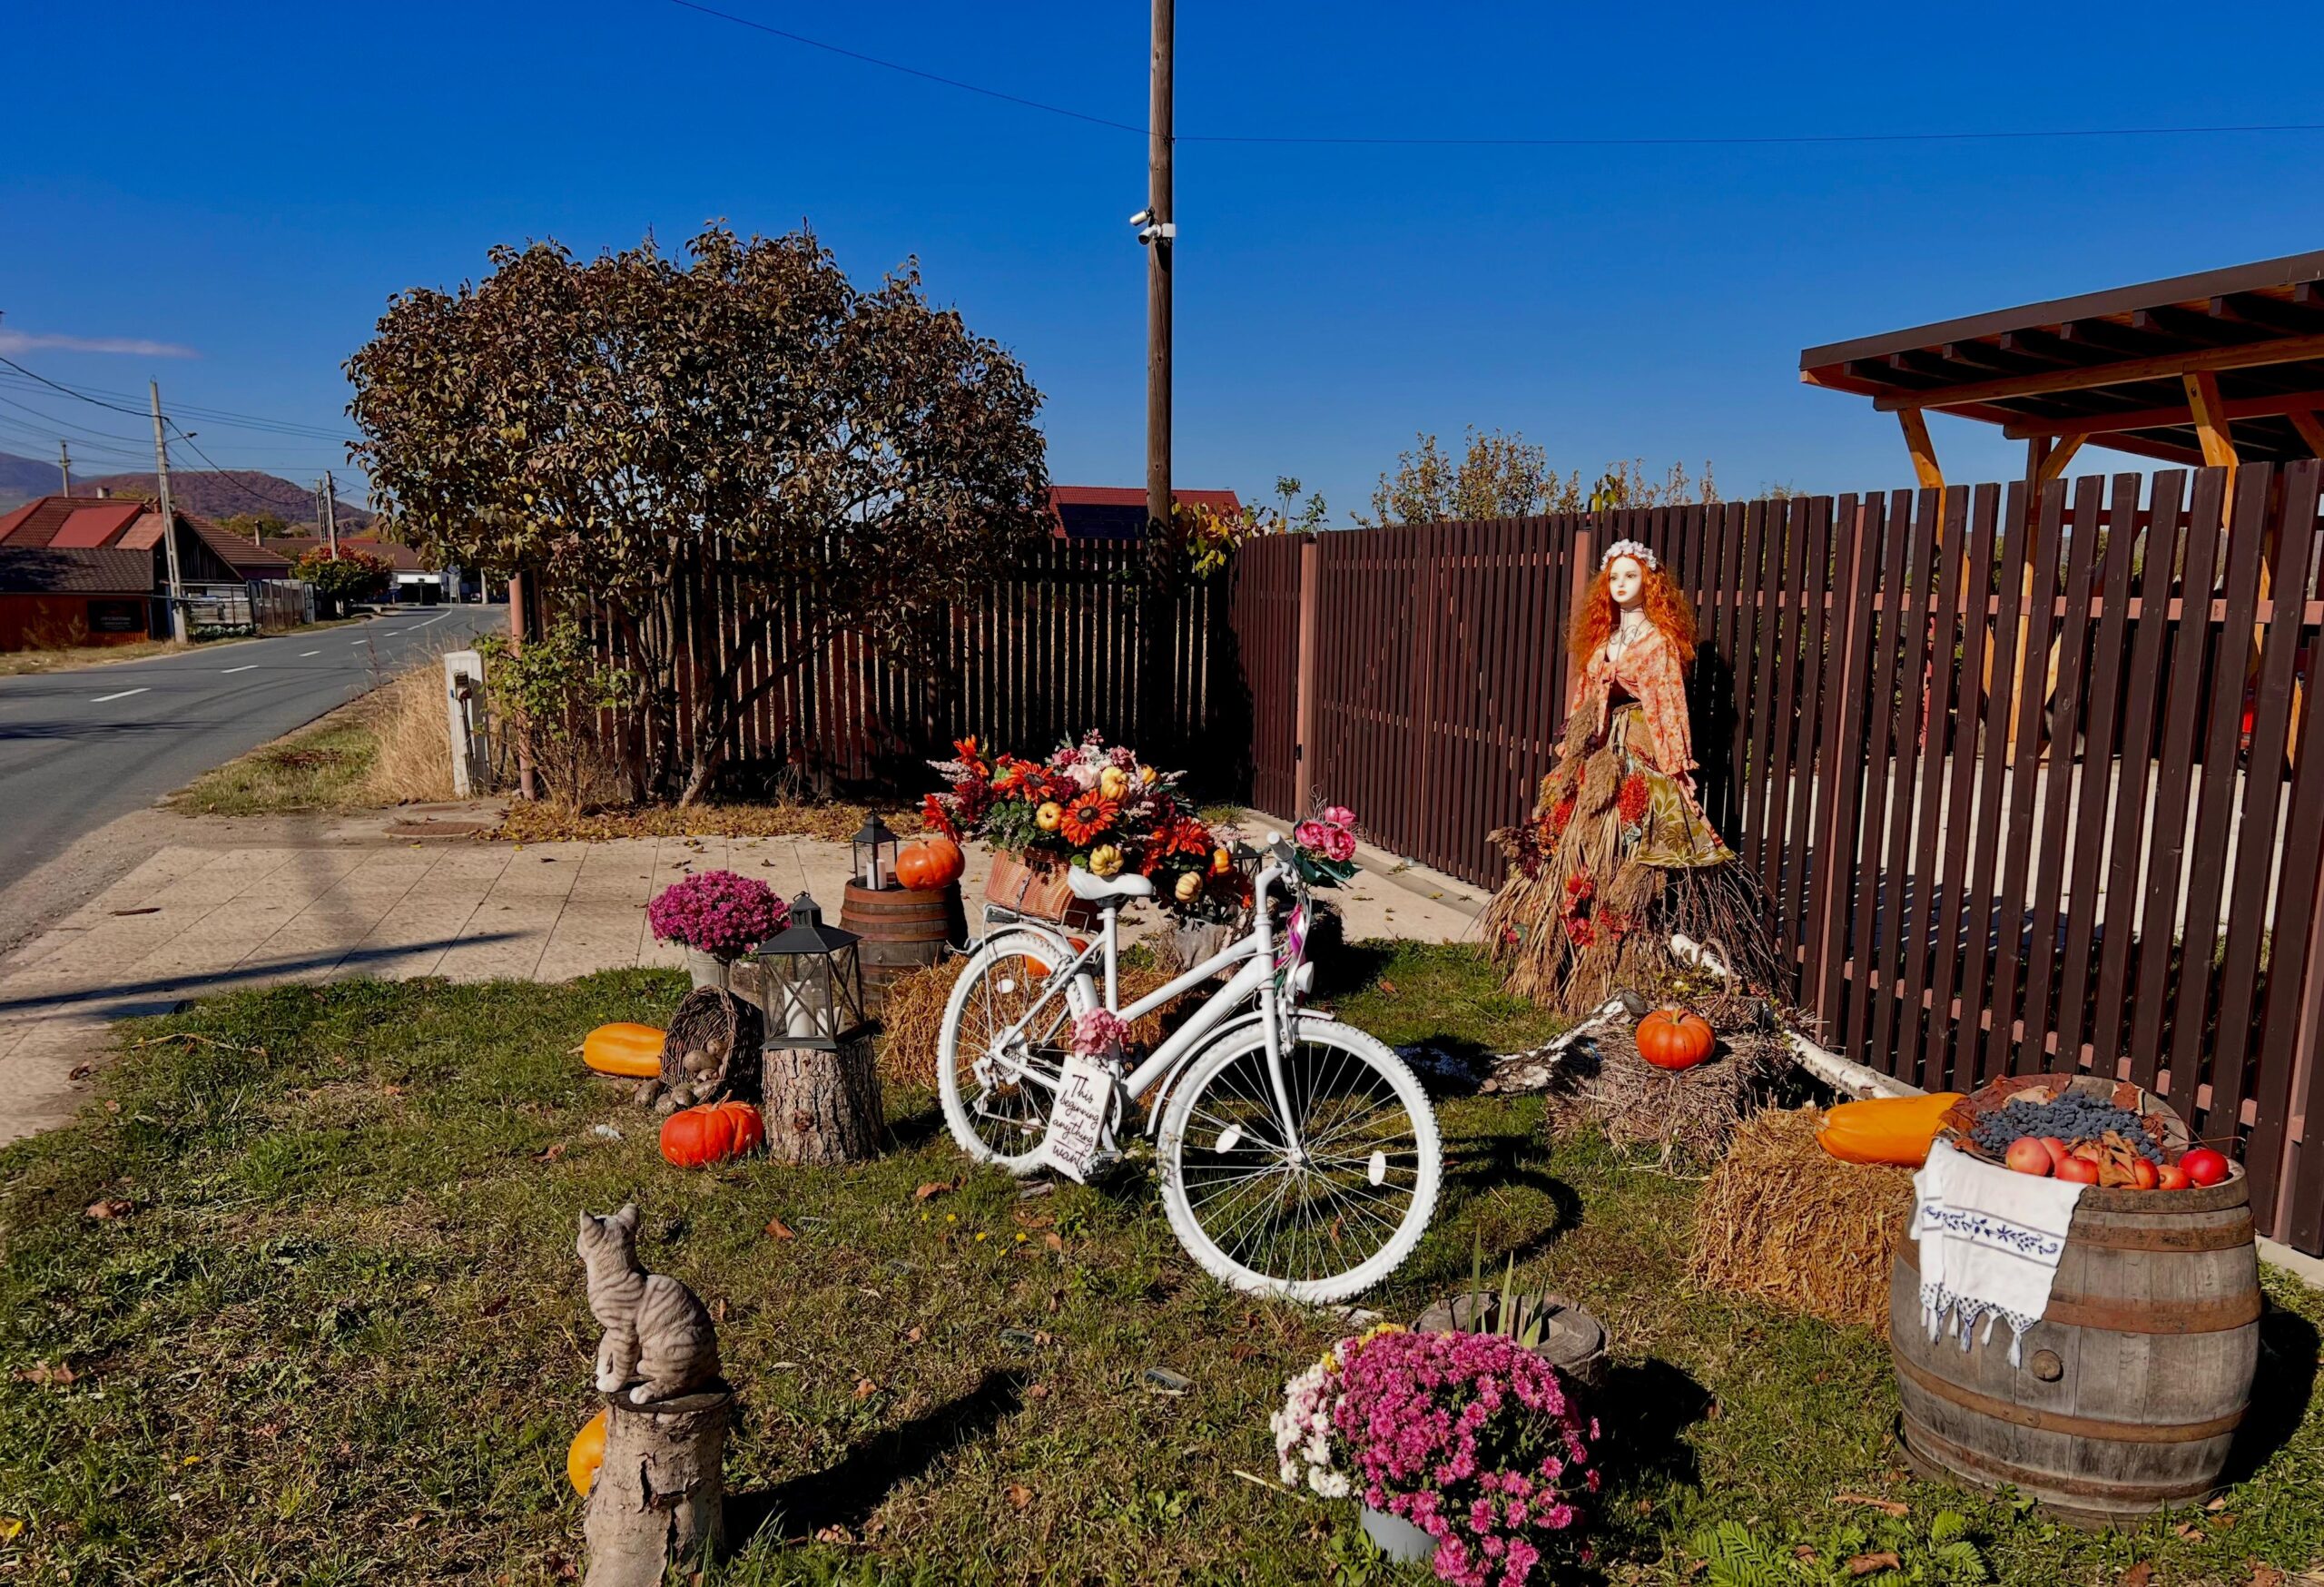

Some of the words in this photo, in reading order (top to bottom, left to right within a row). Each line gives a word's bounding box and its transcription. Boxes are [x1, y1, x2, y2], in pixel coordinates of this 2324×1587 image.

[1071, 1073, 1094, 1104] This
[1059, 1089, 1099, 1130] beginning
[1051, 1119, 1094, 1152] anything
